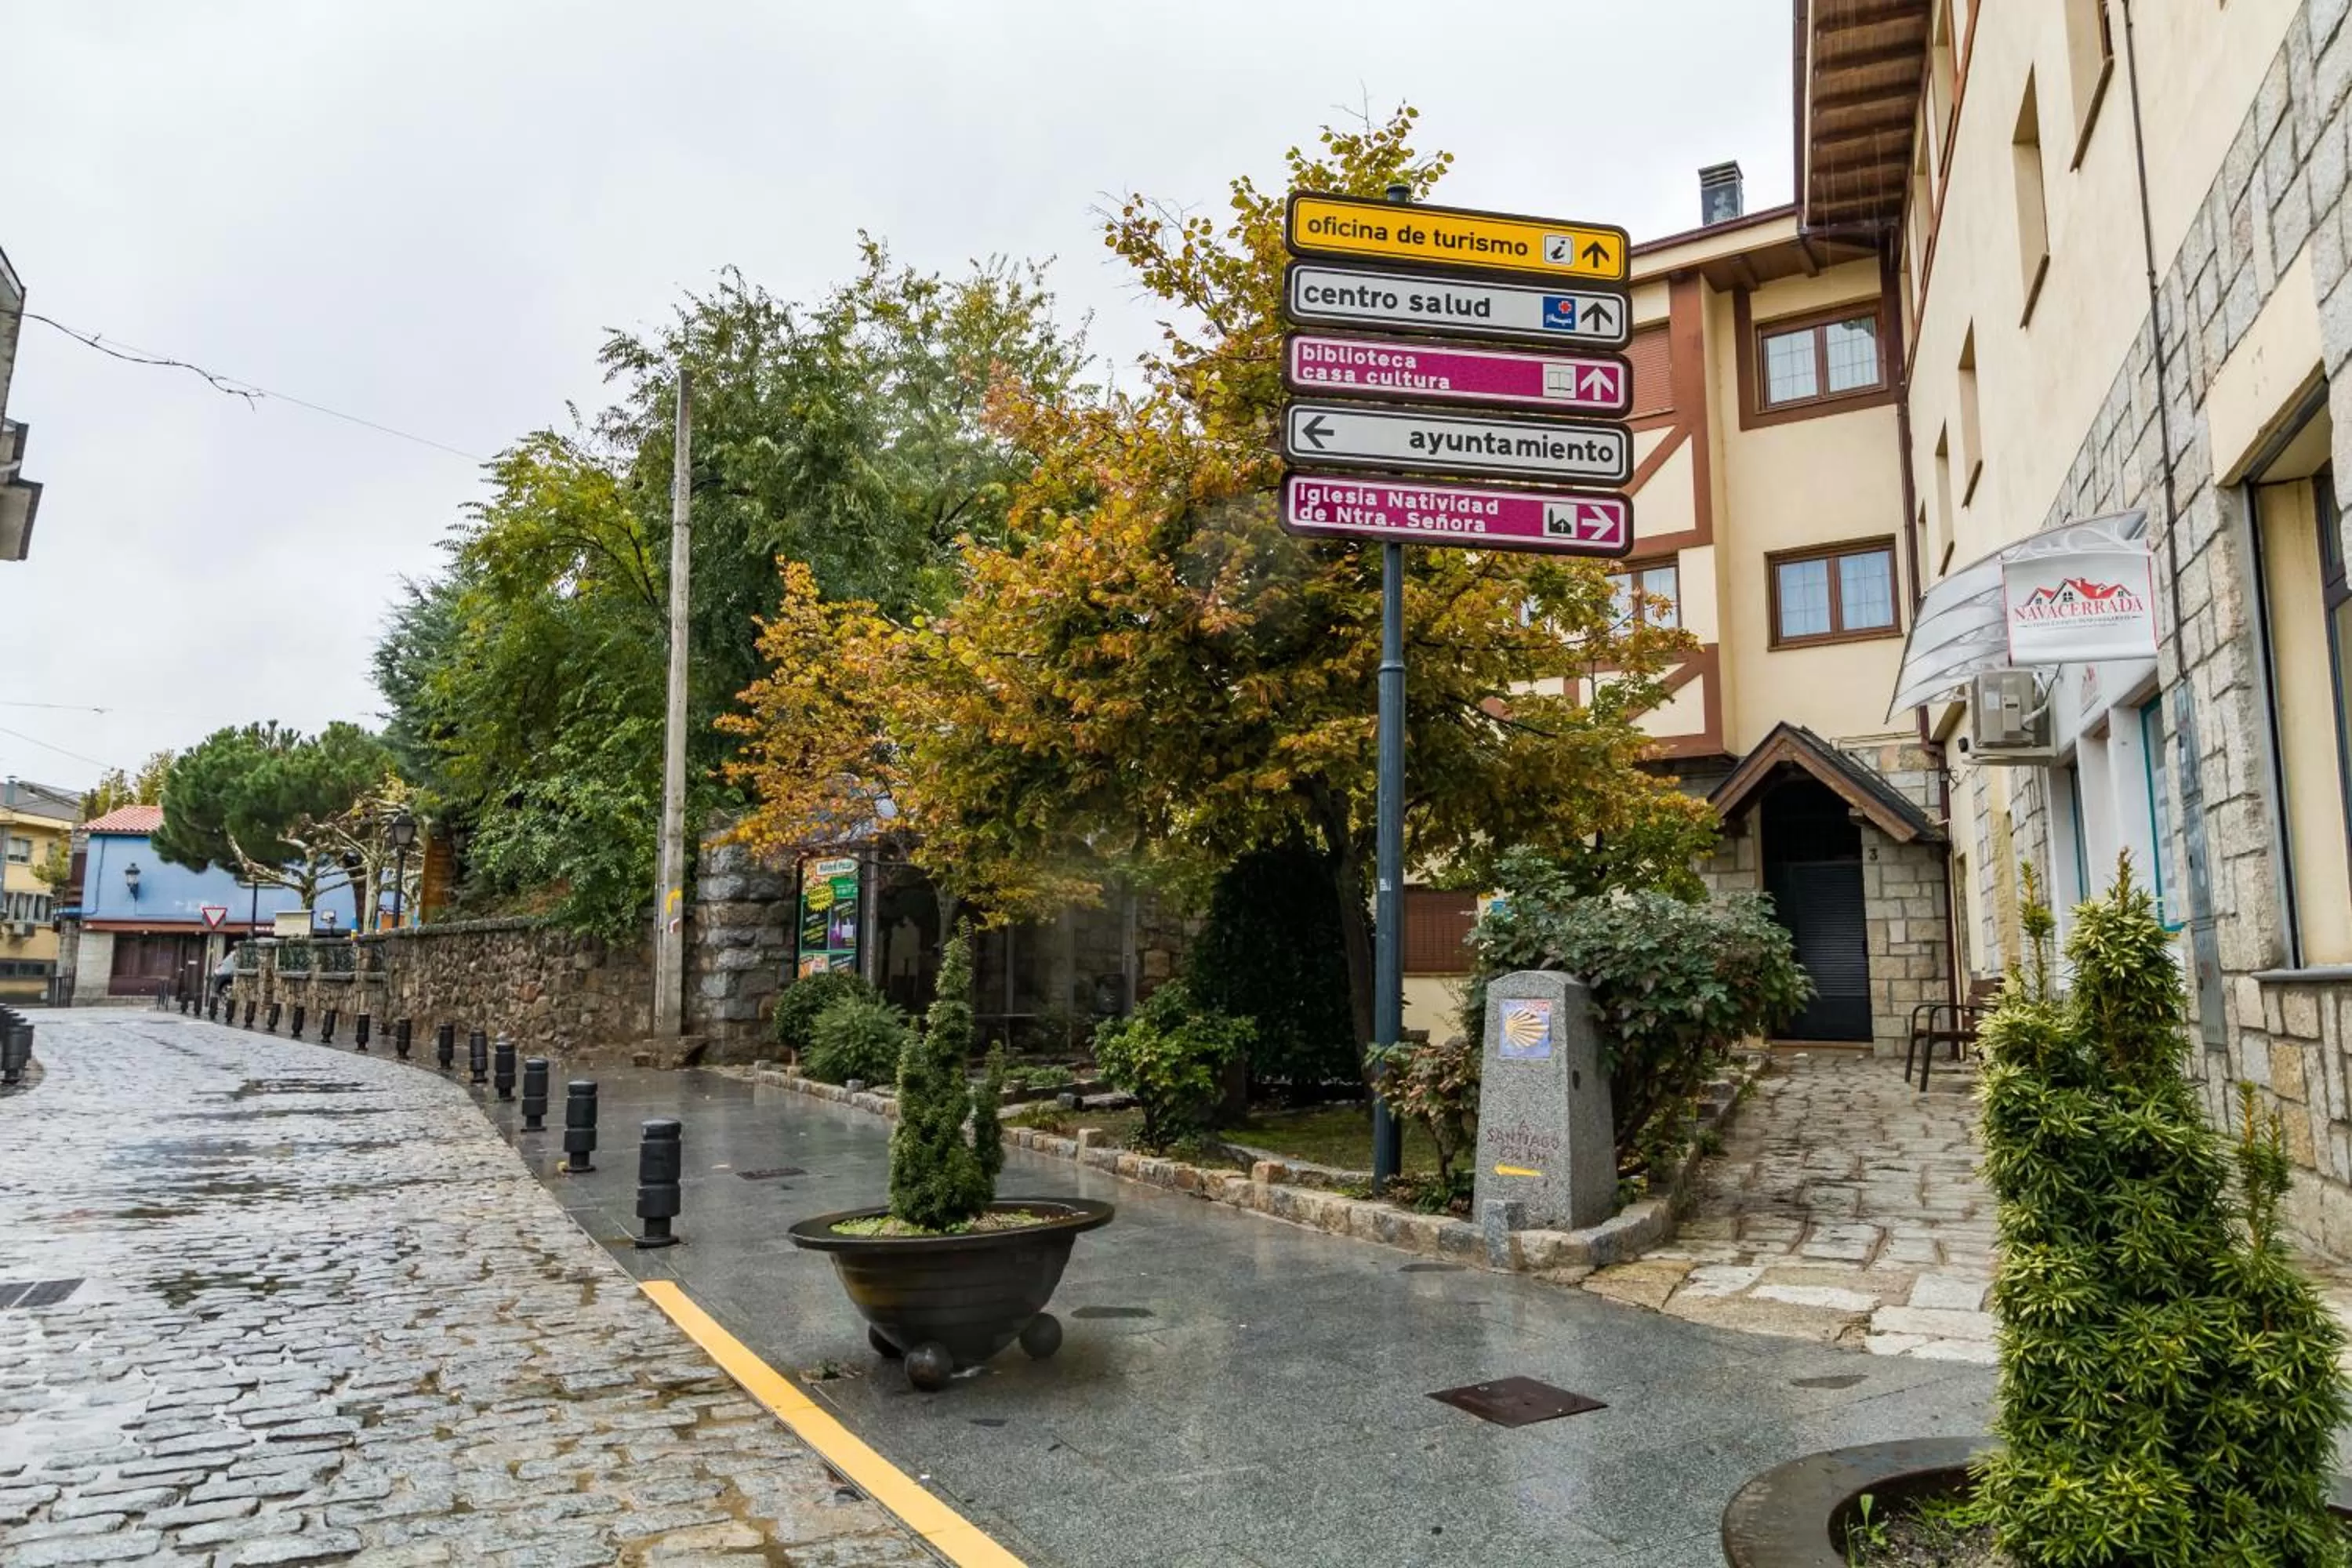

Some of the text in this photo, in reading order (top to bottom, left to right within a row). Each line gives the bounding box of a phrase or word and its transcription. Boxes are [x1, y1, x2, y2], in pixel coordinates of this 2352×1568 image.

[1307, 216, 1388, 241] oficina
[1396, 225, 1425, 245] de
[1433, 229, 1528, 256] turismo
[1303, 282, 1491, 318] centro salud
[1301, 345, 1417, 369] biblioteca
[1301, 367, 1450, 390] casa cultura
[1409, 430, 1615, 463] ayuntamiento
[1387, 491, 1499, 515] Natividad
[1299, 504, 1327, 521] de
[1406, 510, 1486, 533] Señora
[2014, 597, 2143, 621] NAVACERRADA
[1869, 848, 1878, 862] 3
[1486, 1127, 1560, 1150] SANTIAGO
